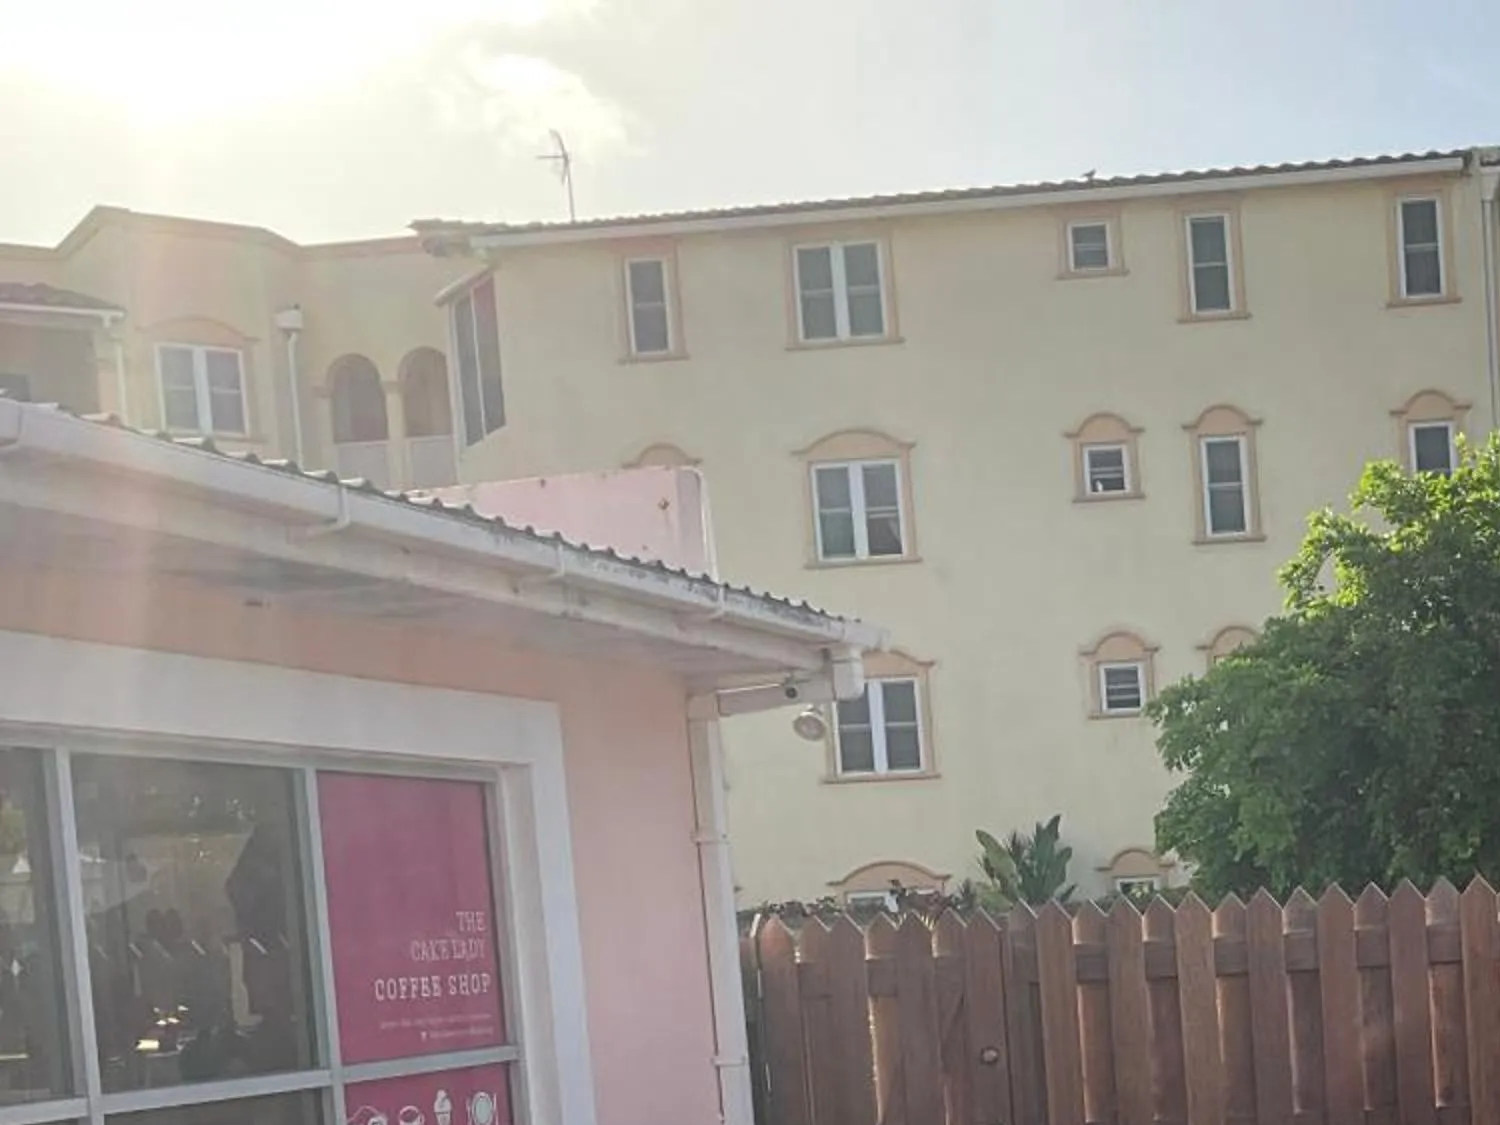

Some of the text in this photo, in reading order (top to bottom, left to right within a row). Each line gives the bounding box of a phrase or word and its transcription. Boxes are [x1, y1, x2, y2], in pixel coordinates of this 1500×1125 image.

[455, 910, 486, 932] THE
[411, 937, 486, 961] CAKE LADY
[374, 973, 491, 1001] COFFEE SHOP
